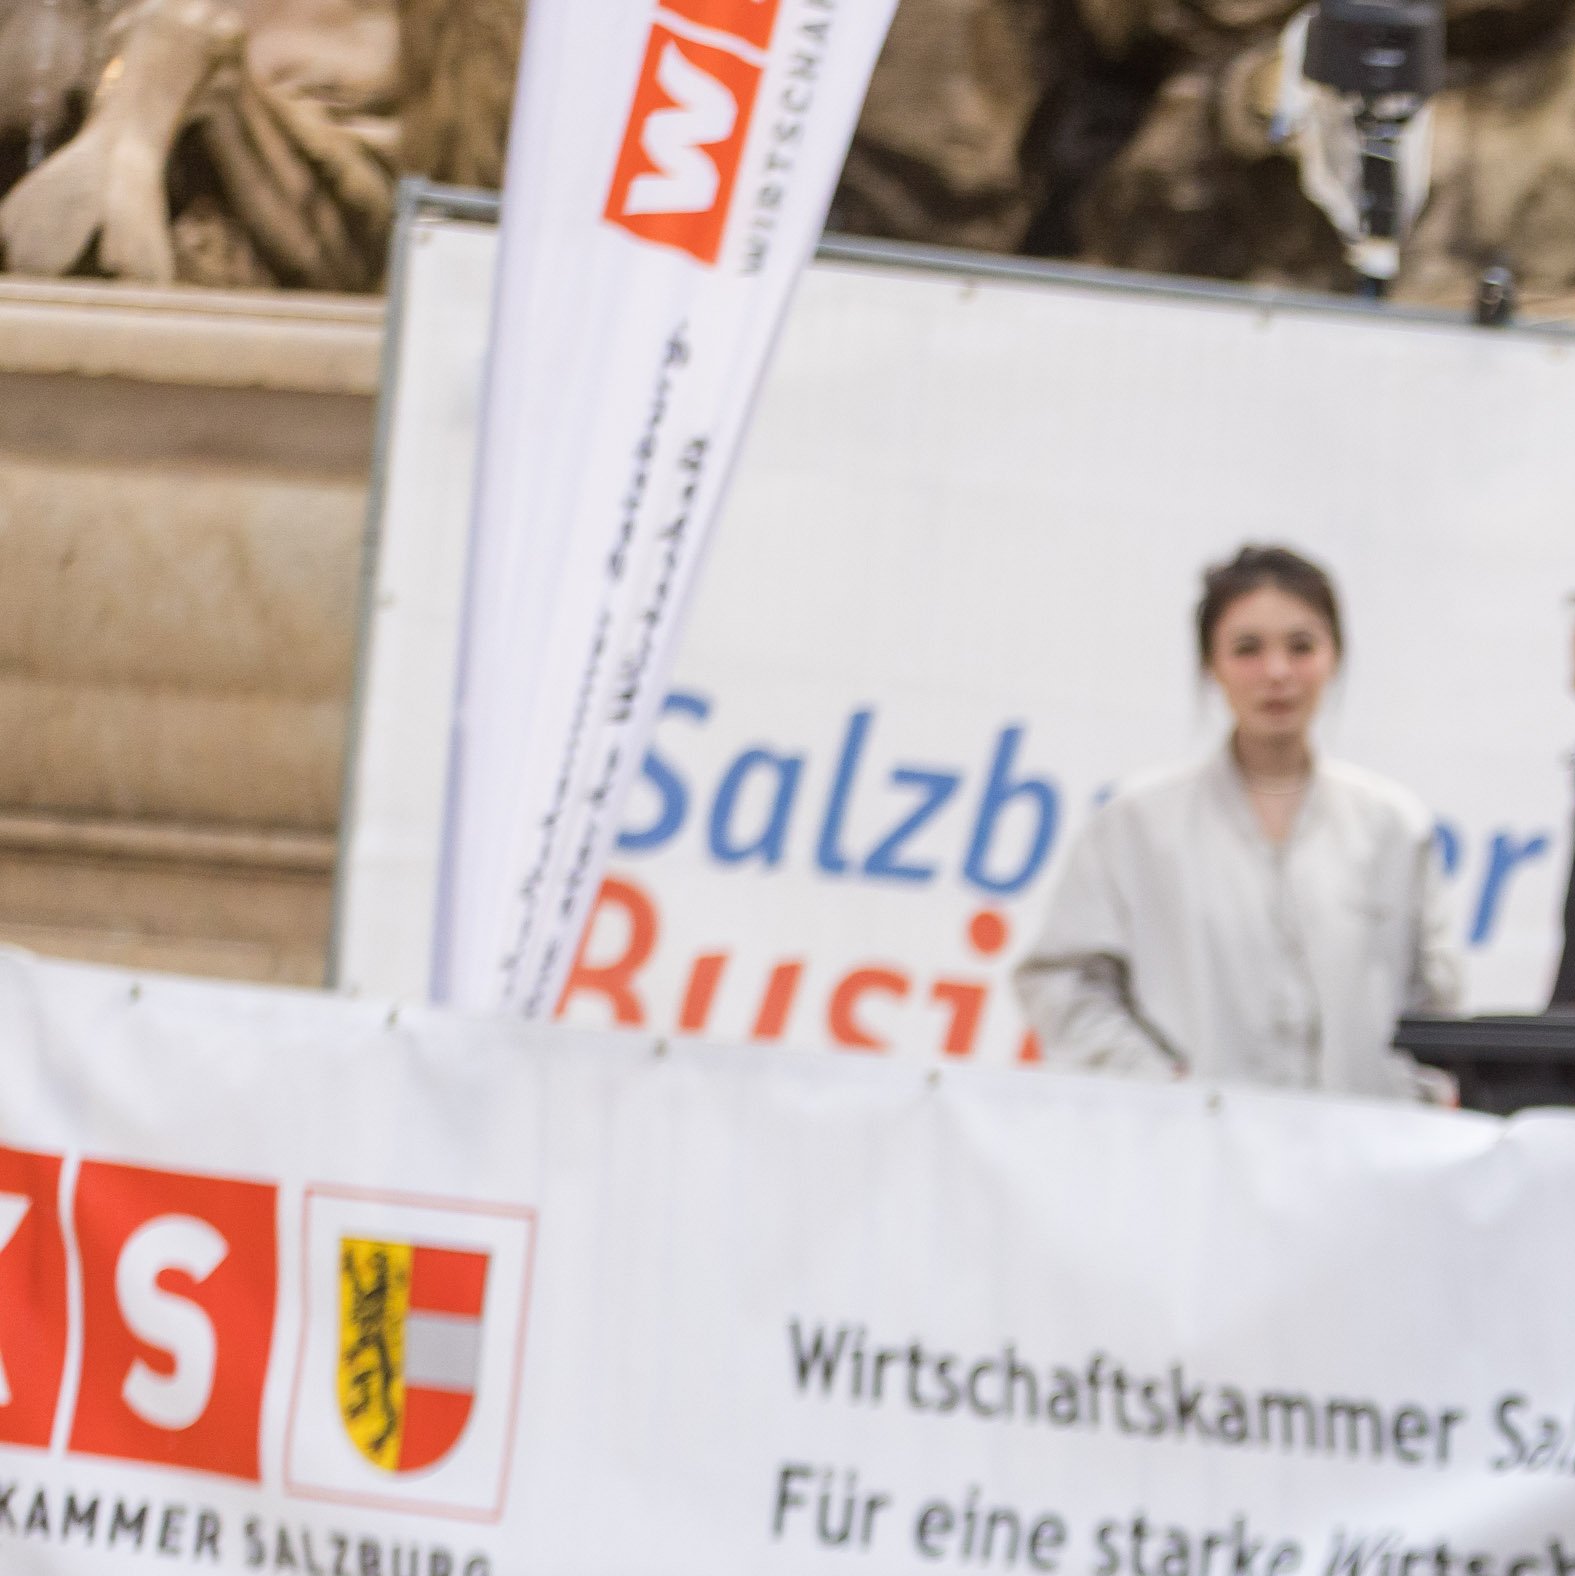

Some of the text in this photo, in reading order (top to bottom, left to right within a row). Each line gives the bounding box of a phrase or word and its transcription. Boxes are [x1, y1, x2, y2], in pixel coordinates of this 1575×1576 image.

[741, 0, 836, 276] WIRTSCHA
[786, 1318, 1464, 1472] Wirtschaftskammer
[771, 1464, 890, 1554] Für
[913, 1484, 1066, 1572] eine
